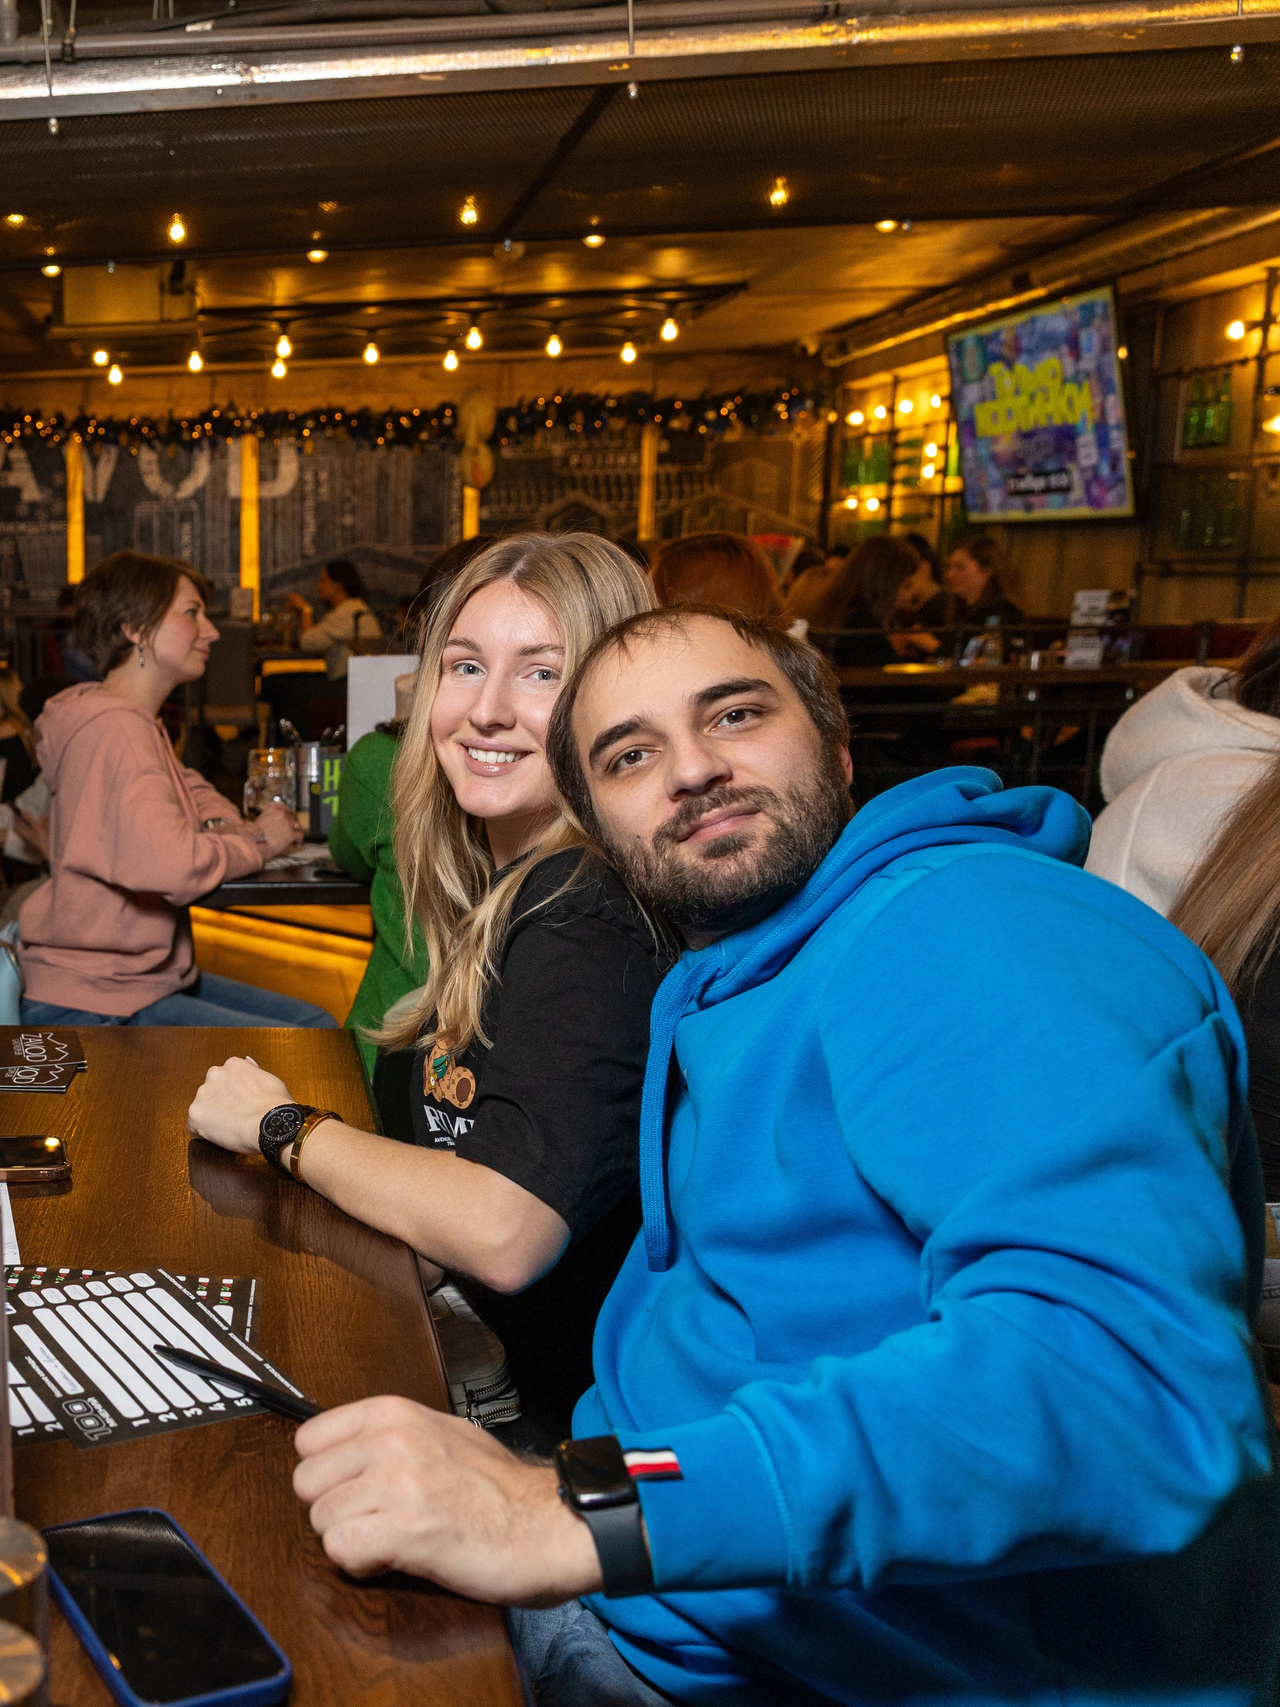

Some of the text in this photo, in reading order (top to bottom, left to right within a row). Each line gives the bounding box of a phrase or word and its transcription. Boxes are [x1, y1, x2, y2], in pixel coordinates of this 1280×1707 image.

[21, 1032, 48, 1063] ZAVOD
[208, 1402, 227, 1412] 4
[233, 1398, 254, 1407] 5
[86, 1396, 118, 1428] МНЕНИЙ
[157, 1411, 179, 1423] 2
[183, 1407, 203, 1418] 3
[62, 1398, 112, 1441] 100
[131, 1418, 151, 1428] 1
[16, 1427, 36, 1437] 1
[44, 1421, 64, 1433] 2
